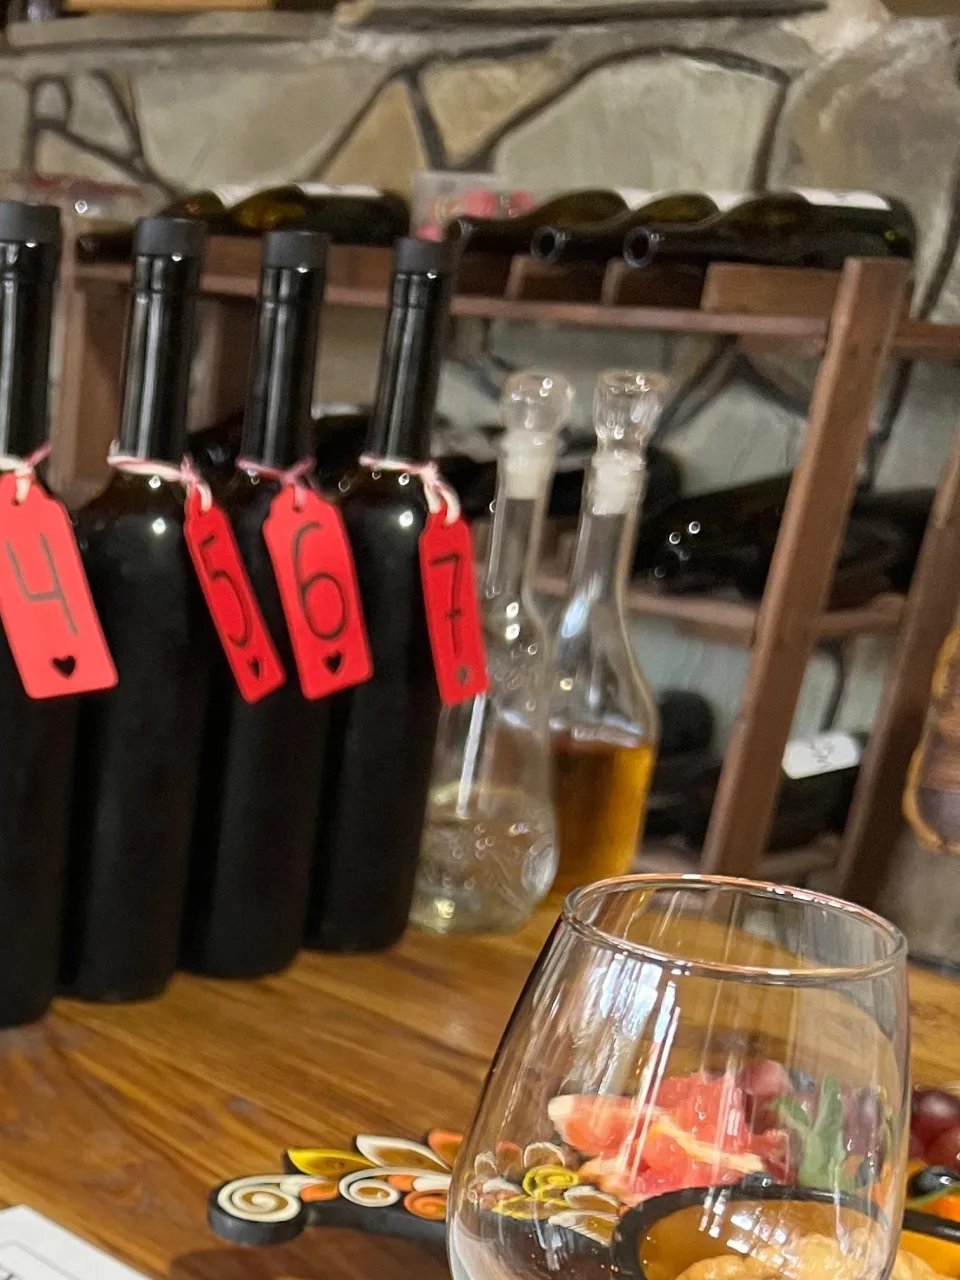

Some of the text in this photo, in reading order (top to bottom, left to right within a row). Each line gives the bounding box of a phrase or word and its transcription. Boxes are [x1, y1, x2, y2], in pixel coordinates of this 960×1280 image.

[6, 533, 79, 637] 4
[201, 533, 249, 649] 5
[290, 521, 350, 641] 6
[429, 553, 464, 658] 7
